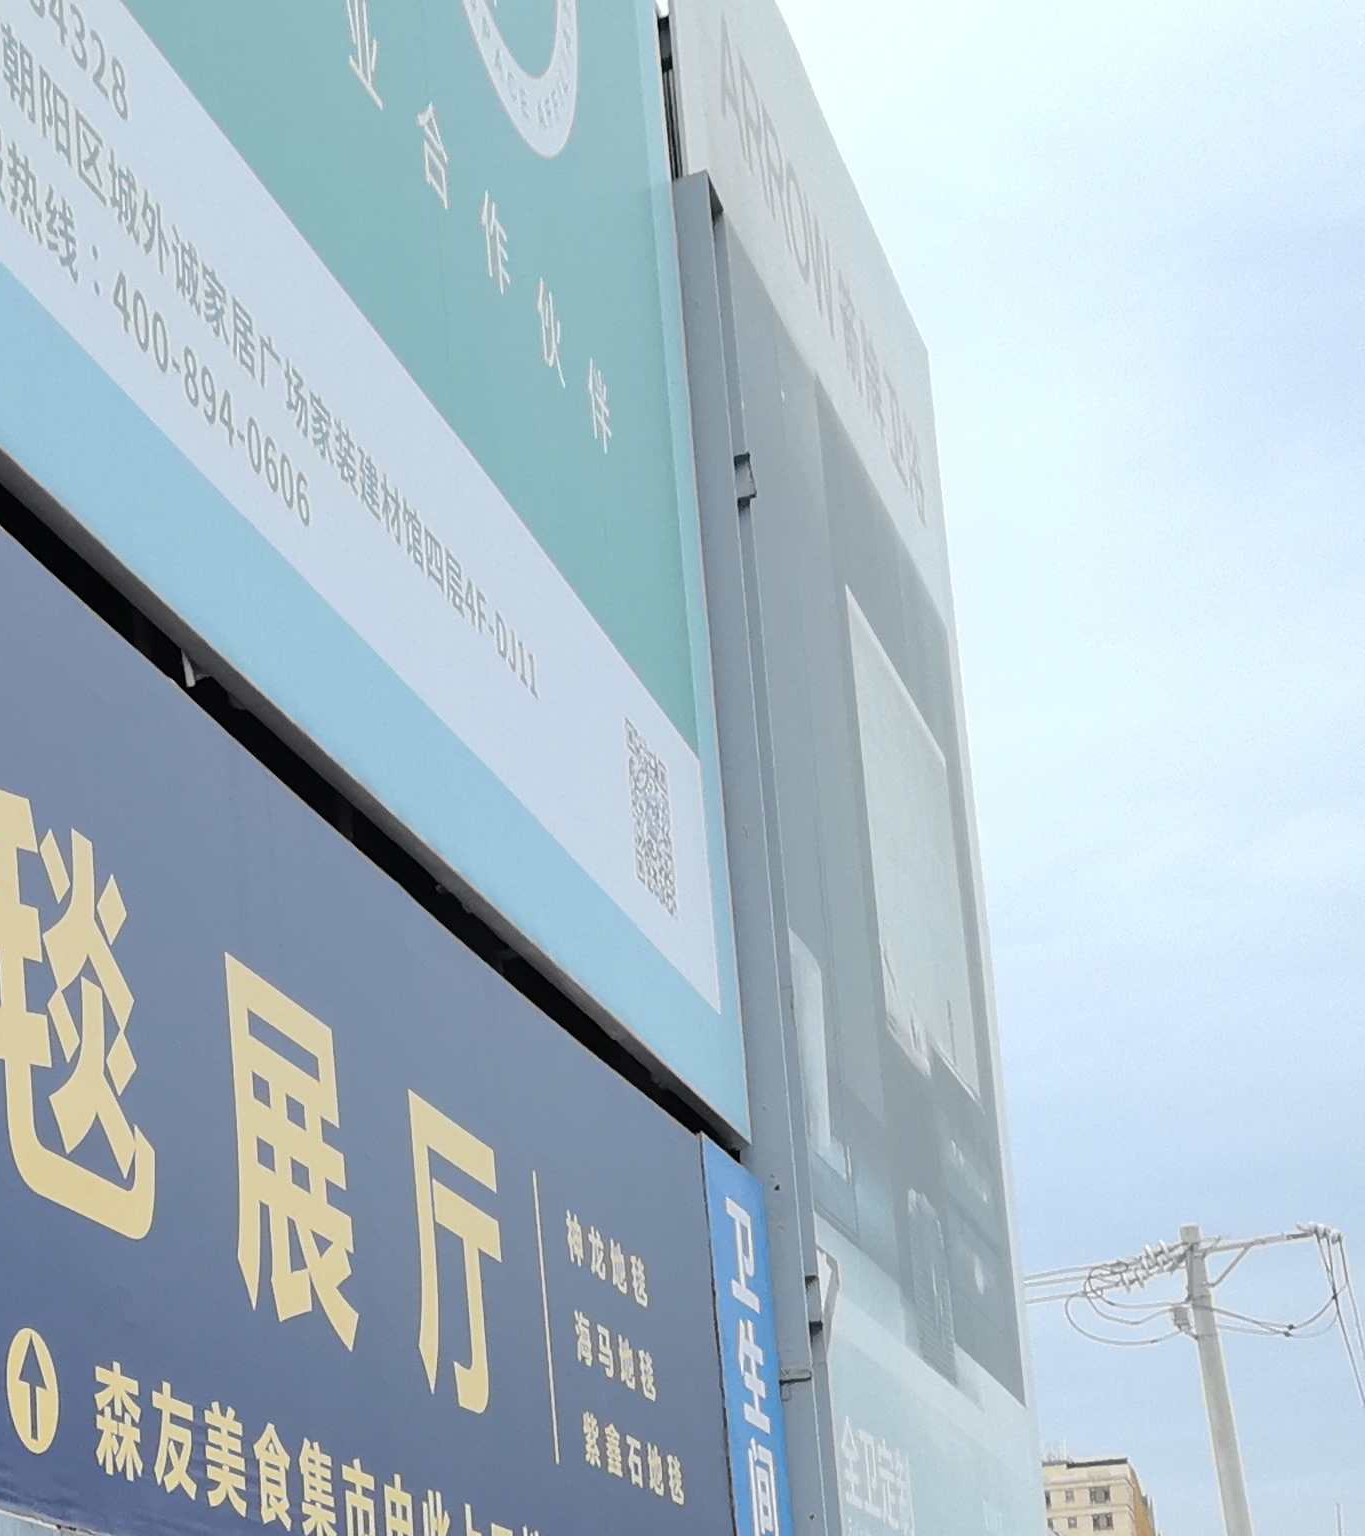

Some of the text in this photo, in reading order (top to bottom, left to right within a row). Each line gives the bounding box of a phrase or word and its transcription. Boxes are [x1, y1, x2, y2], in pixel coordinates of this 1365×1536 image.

[29, 0, 128, 121] 4328
[565, 1209, 649, 1308] 神龙地毯
[573, 1310, 657, 1403] 海马地毯
[581, 1410, 685, 1506] 紫鑫石地毯
